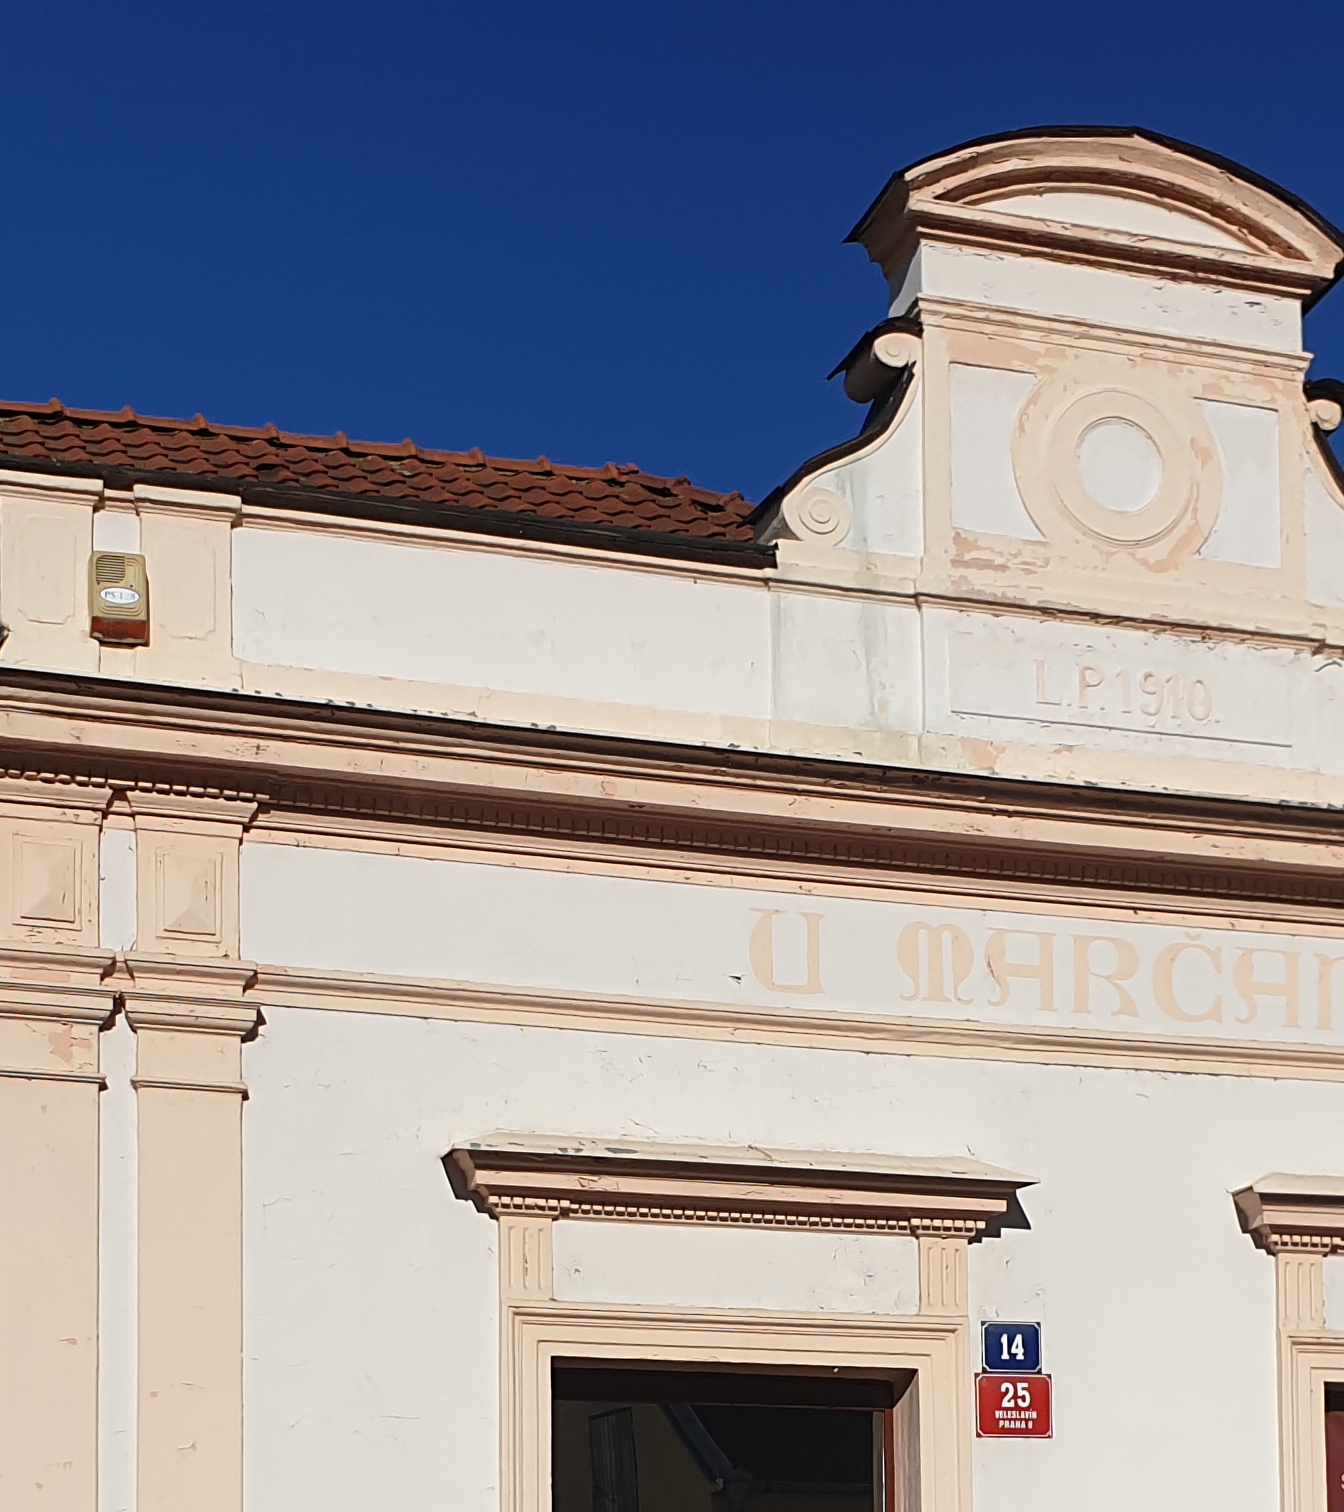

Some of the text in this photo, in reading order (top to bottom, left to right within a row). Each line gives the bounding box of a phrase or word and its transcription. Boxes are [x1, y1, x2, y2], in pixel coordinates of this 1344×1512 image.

[748, 907, 825, 994] U
[1000, 1333, 1025, 1360] 14
[1000, 1382, 1031, 1408] 25
[999, 1420, 1026, 1428] PRAHA
